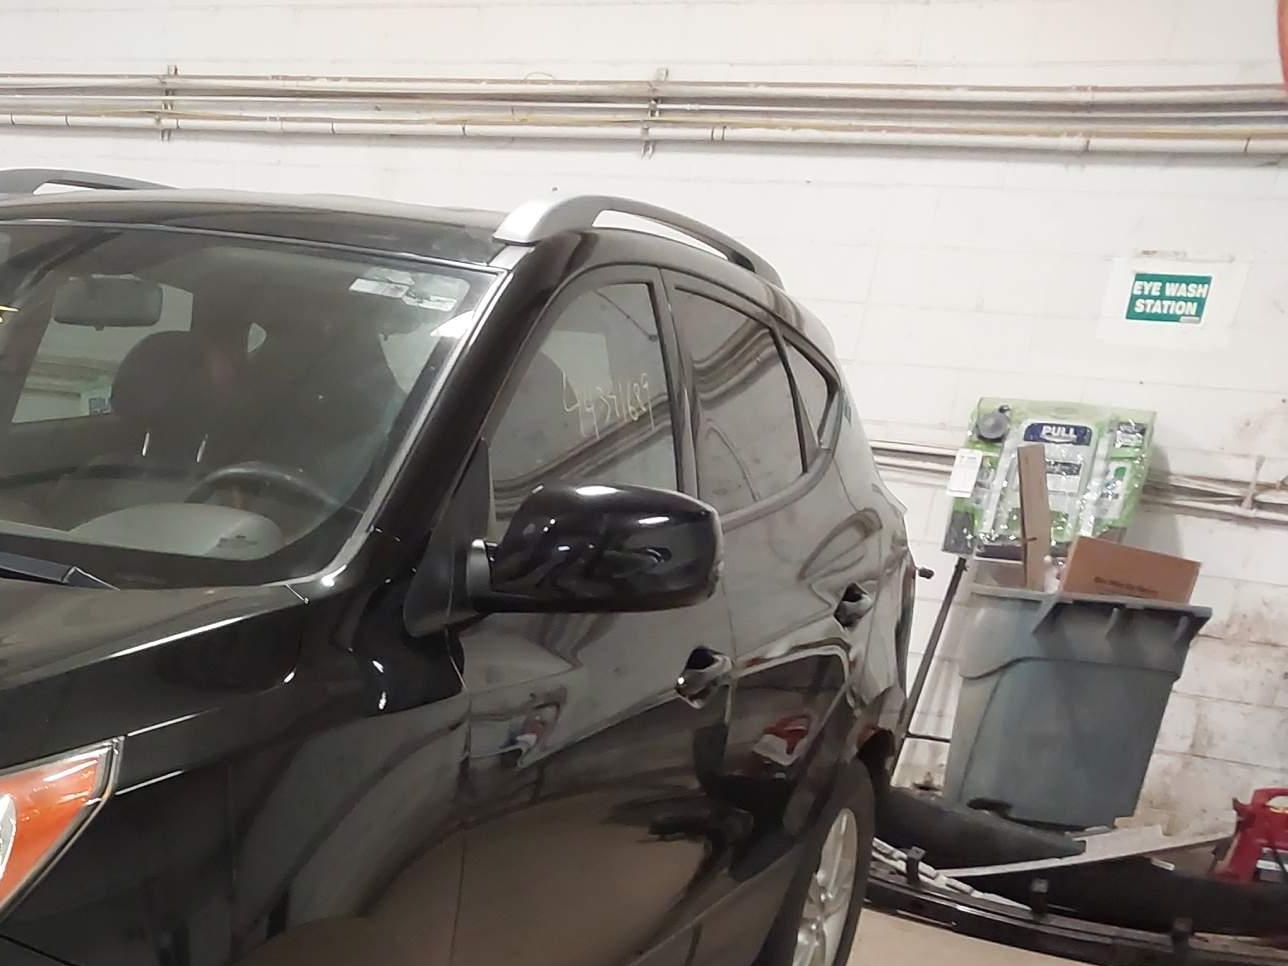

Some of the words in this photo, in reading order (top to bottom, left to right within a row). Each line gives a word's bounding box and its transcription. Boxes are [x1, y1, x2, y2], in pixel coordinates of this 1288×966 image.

[1132, 280, 1163, 296] EYE
[1165, 282, 1209, 298] WASH
[1134, 298, 1198, 315] STATION
[1041, 425, 1078, 439] PULL
